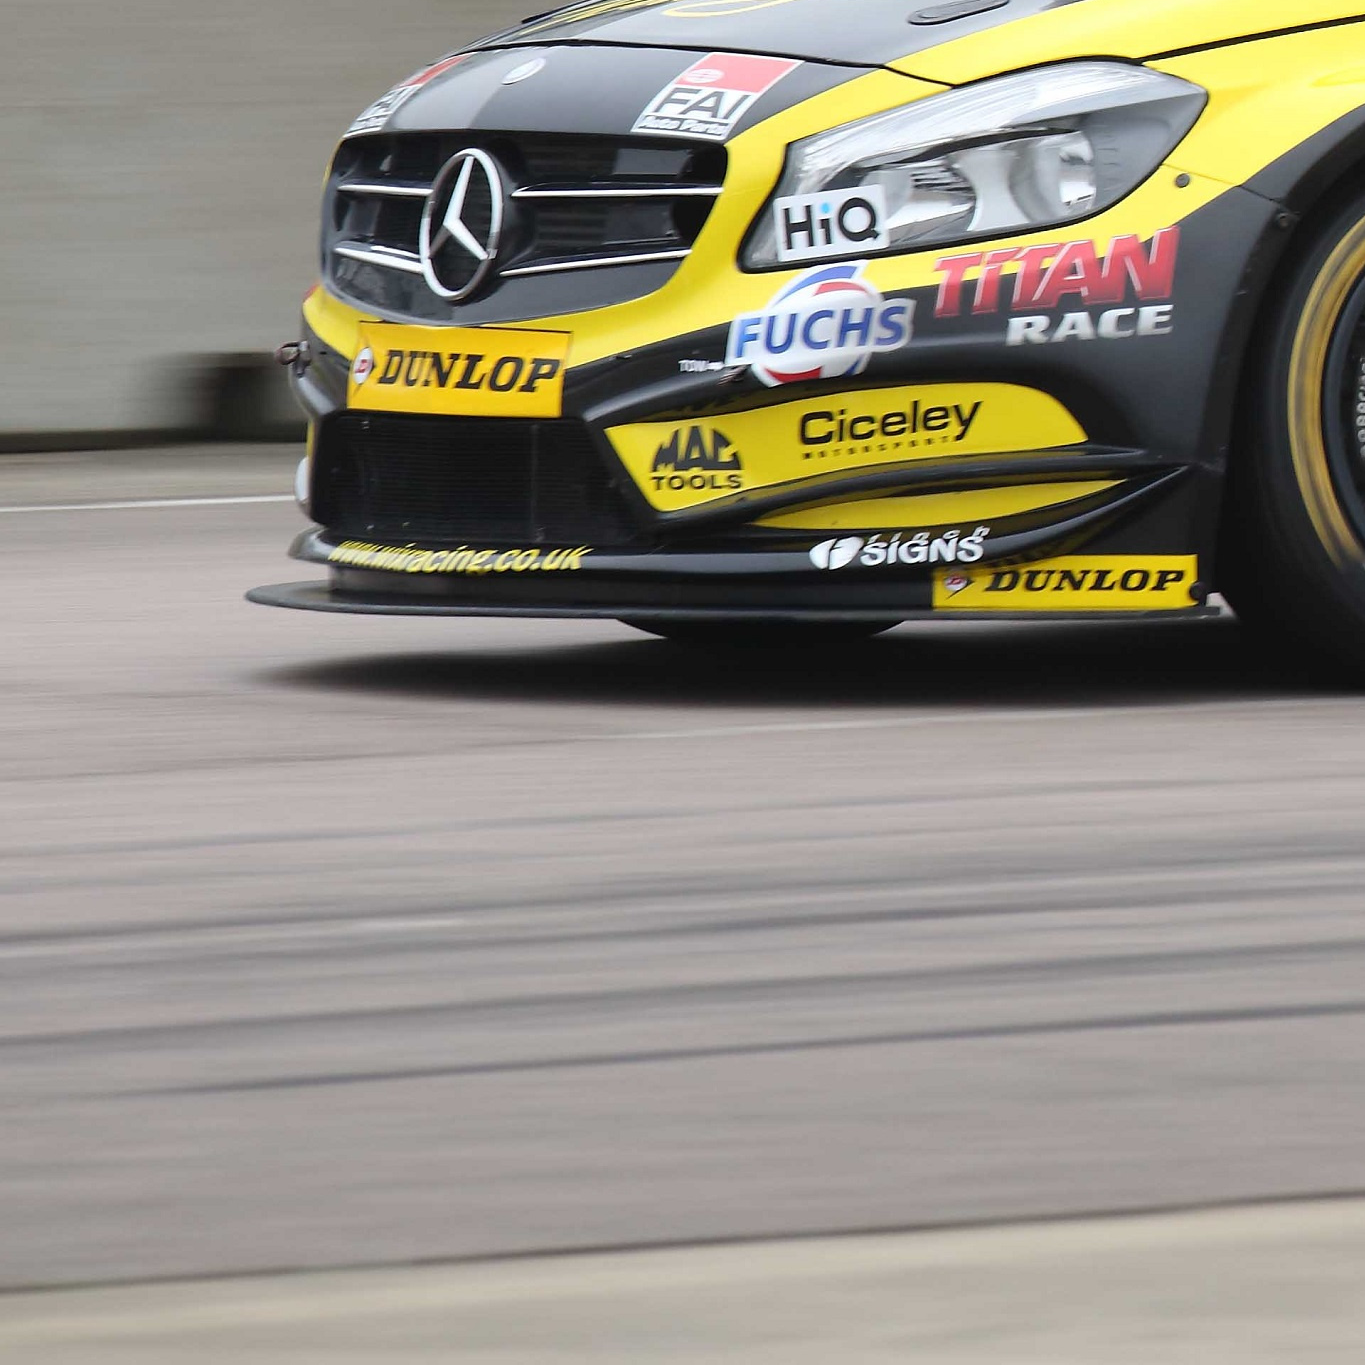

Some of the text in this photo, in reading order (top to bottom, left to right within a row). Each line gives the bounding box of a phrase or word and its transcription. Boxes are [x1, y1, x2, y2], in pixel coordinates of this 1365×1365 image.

[653, 87, 752, 120] FAI
[782, 197, 880, 251] HiQ
[734, 305, 906, 359] FUCHS
[1005, 304, 1175, 347] RACE
[377, 349, 562, 393] DUNLOP
[800, 399, 984, 446] Ciceley
[651, 425, 743, 472] MAC
[651, 473, 742, 491] TOOLS
[328, 539, 595, 576] www.wixracing.co.uk
[859, 536, 985, 567] SIGNS
[984, 569, 1185, 592] DUNLOP
